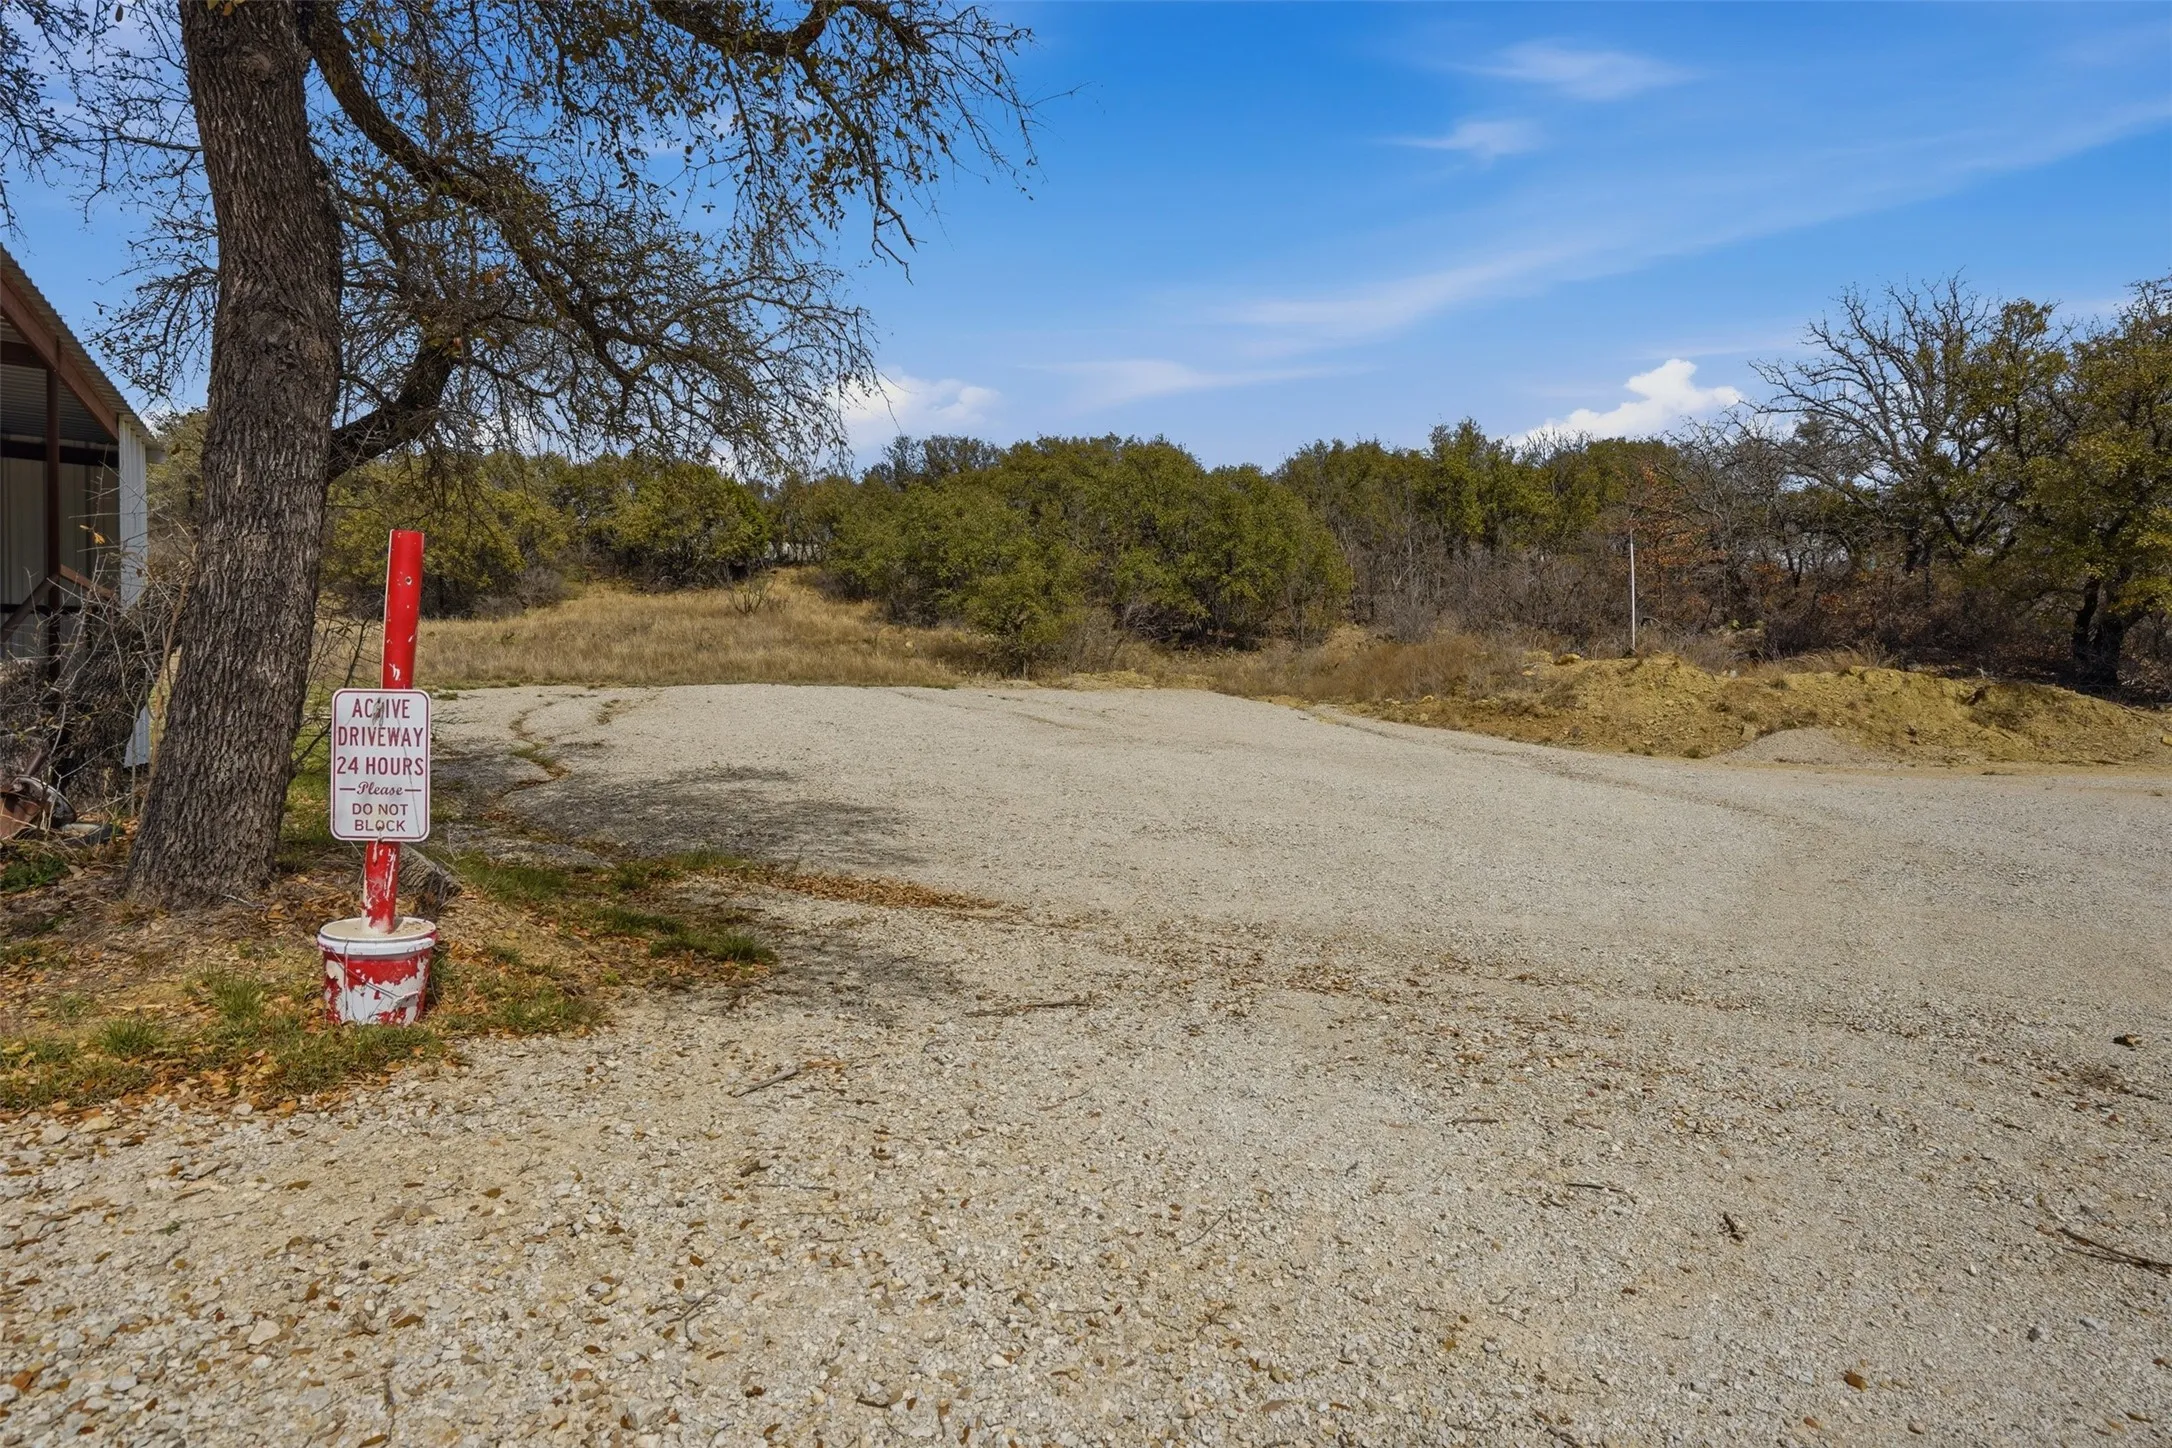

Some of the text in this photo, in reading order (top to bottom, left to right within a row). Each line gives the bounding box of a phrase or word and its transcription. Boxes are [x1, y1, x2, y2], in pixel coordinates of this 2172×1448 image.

[352, 698, 410, 719] ACIVE
[338, 726, 424, 747] DRIVEWAY
[336, 756, 424, 775] 24 HOURS
[356, 781, 403, 795] Please
[352, 803, 408, 816] DO NOT
[354, 819, 405, 832] BLOCK
